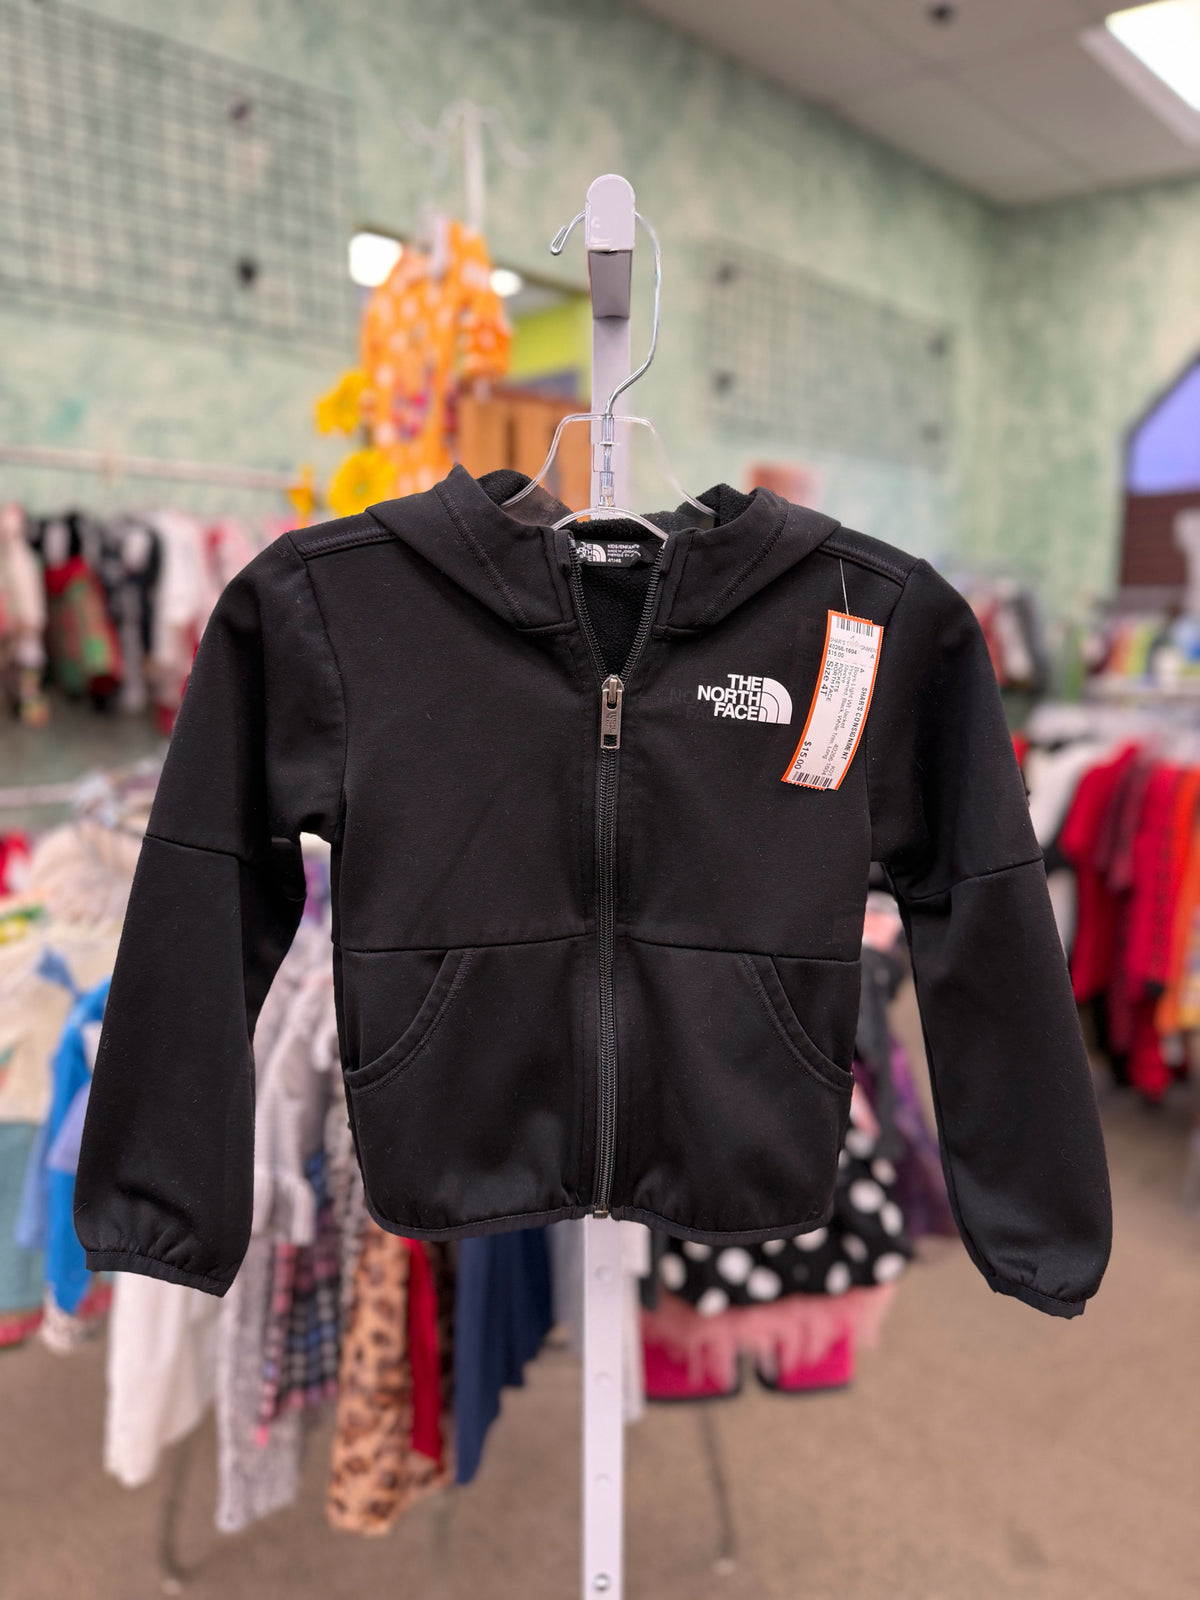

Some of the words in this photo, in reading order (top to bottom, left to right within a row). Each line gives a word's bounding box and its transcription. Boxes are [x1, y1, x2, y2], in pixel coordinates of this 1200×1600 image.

[828, 649, 845, 658] $15.00
[823, 660, 834, 681] Size
[831, 661, 840, 684] NORTH
[833, 663, 844, 692] POCKETS
[727, 673, 763, 692] THE
[820, 684, 828, 696] 4T
[697, 685, 761, 707] NORTH
[826, 685, 835, 702] FACE
[857, 687, 867, 711] SHAR'S
[713, 702, 760, 721] FACE
[840, 709, 849, 729] Jacket
[841, 712, 862, 760] CONSIGNMENT
[794, 740, 812, 770] $15.00
[822, 746, 832, 760] Long
